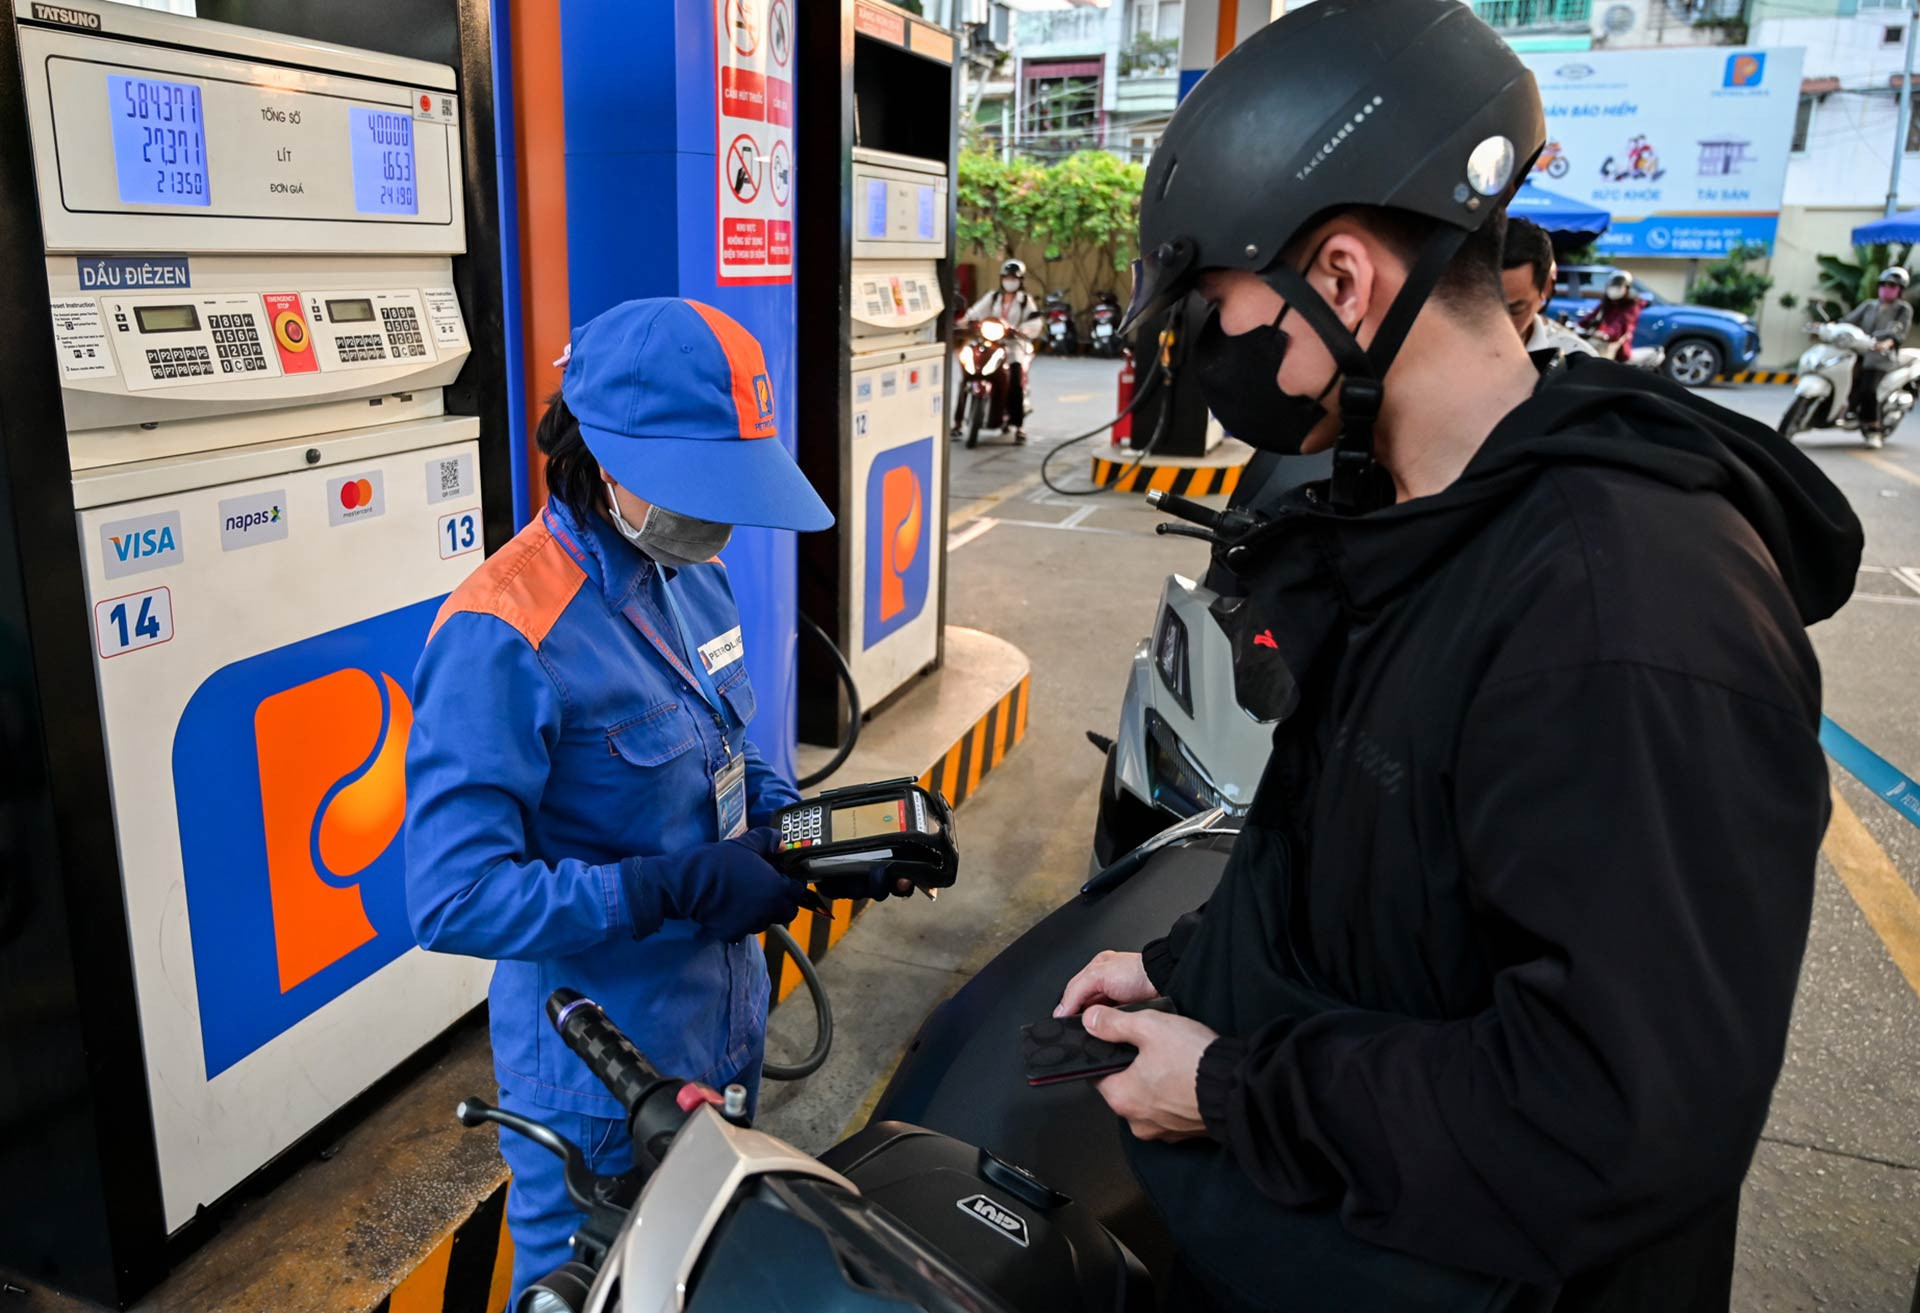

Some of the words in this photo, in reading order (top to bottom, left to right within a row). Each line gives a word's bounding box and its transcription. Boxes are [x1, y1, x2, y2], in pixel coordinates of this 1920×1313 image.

[34, 5, 98, 28] TATSUNO
[125, 81, 196, 124] 584371
[289, 110, 301, 125] SỐ
[368, 114, 409, 146] 40000
[143, 126, 200, 166] 27,371
[277, 147, 292, 162] LÍT
[157, 170, 202, 195] 21350
[270, 183, 289, 194] ĐƠN
[289, 182, 304, 195] GIÁ
[83, 261, 120, 286] DẦU
[125, 263, 186, 285] ĐIÊZEN
[382, 309, 388, 318] 7
[391, 309, 398, 318] 8
[399, 309, 406, 318] 9
[210, 317, 217, 327] 7
[222, 316, 230, 327] 8
[234, 316, 241, 326] 9
[386, 322, 392, 331] 4
[395, 322, 401, 331] 5
[404, 321, 410, 331] 6
[215, 331, 222, 341] 4
[227, 331, 234, 341] 5
[238, 330, 245, 340] 6
[398, 334, 405, 343] 2
[147, 352, 158, 361] P1
[160, 351, 171, 360] P2
[173, 350, 183, 360] P3
[185, 349, 196, 359] P4
[219, 346, 226, 357] 1
[231, 345, 239, 356] 2
[242, 345, 249, 355] 3
[152, 367, 163, 377] P6
[165, 366, 175, 376] P7
[177, 365, 188, 375] P8
[190, 364, 200, 374] P9
[223, 361, 231, 371] 0
[235, 360, 243, 370] C
[856, 414, 867, 435] 12
[343, 507, 373, 518] mastercard
[226, 510, 269, 532] napas
[447, 515, 475, 551] 13
[108, 526, 175, 562] VISA
[110, 596, 160, 647] 14
[973, 1199, 1021, 1230] GIVI
